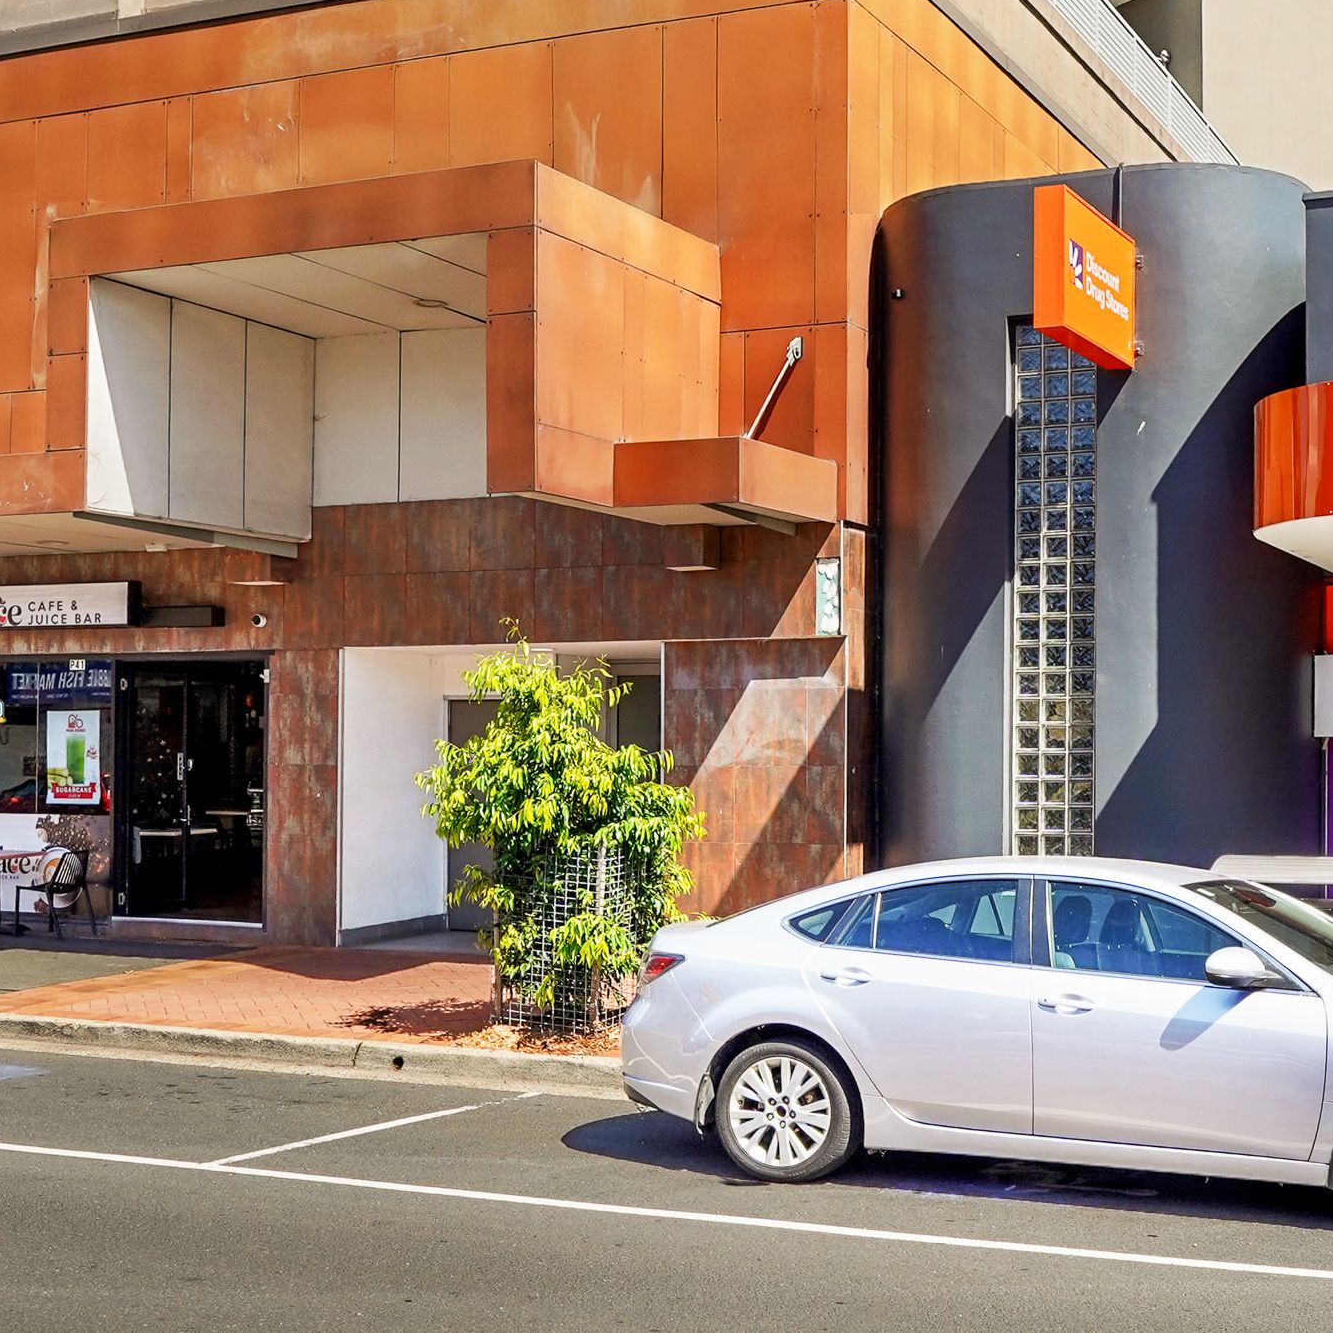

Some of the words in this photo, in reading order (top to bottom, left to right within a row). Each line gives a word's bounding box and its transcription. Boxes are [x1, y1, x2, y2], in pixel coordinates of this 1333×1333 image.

[1085, 251, 1120, 294] Discount
[1085, 274, 1105, 311] Drug
[1105, 289, 1130, 322] Stores
[28, 601, 63, 612] CAFE
[70, 600, 78, 610] &
[28, 613, 67, 625] JUICE
[74, 612, 102, 624] BAR
[69, 660, 86, 670] P41
[55, 785, 92, 794] SUGARCANE
